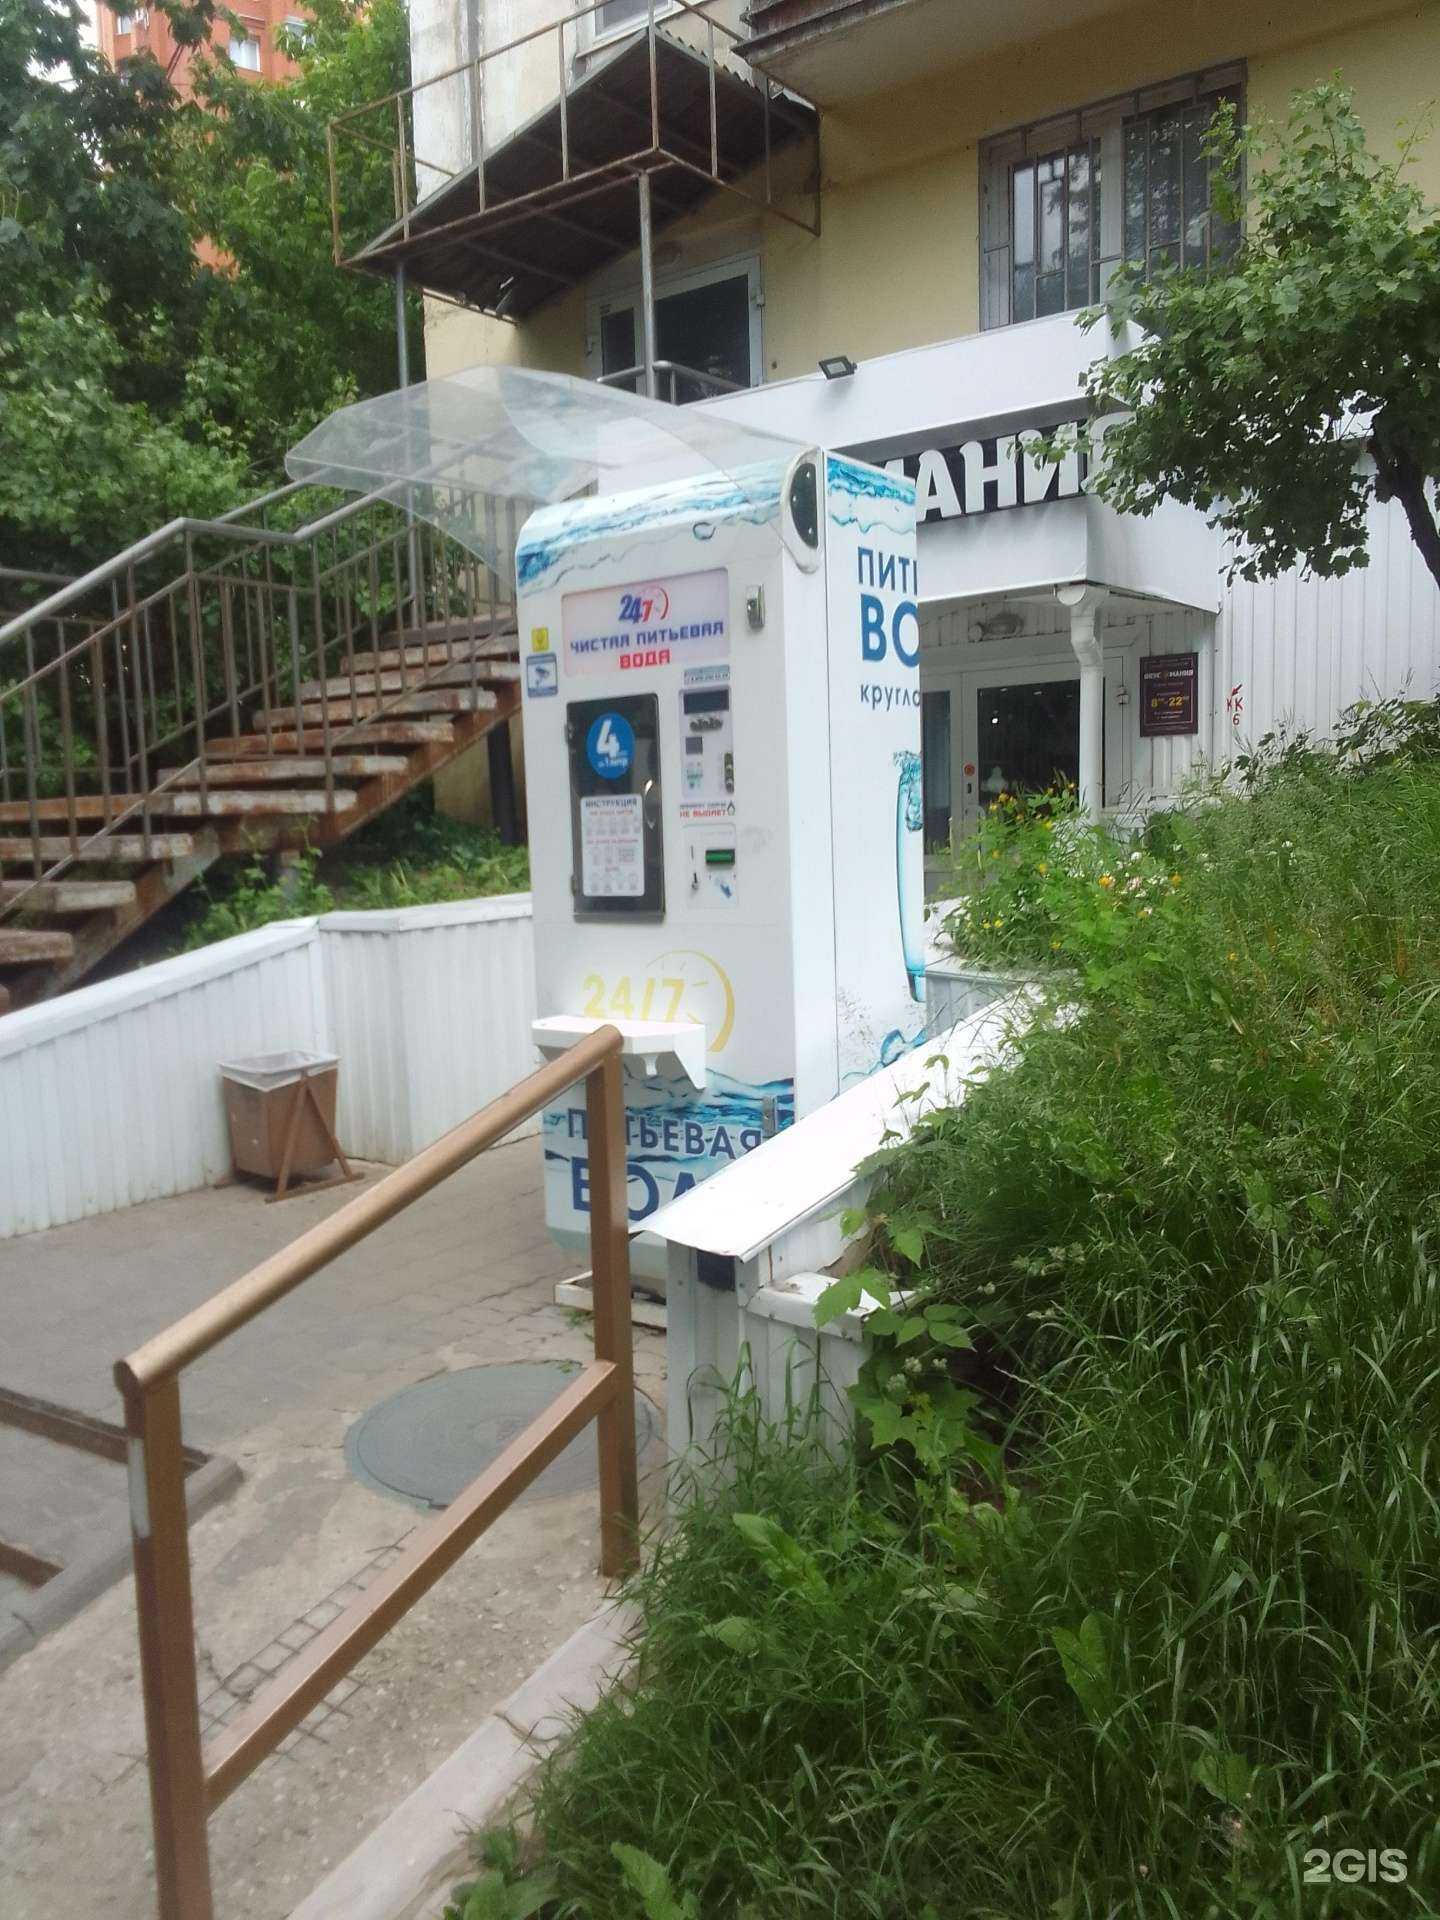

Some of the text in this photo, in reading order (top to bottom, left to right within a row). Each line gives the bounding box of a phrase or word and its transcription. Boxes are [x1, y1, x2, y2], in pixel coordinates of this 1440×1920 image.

[570, 621, 724, 653] ЧИСТАЯ ПИТЬЕВАЯ
[619, 648, 671, 669] ВОДА
[596, 718, 620, 760] 4
[583, 974, 685, 1024] 24/7
[567, 1108, 762, 1161] ПТЬЕВАЯ
